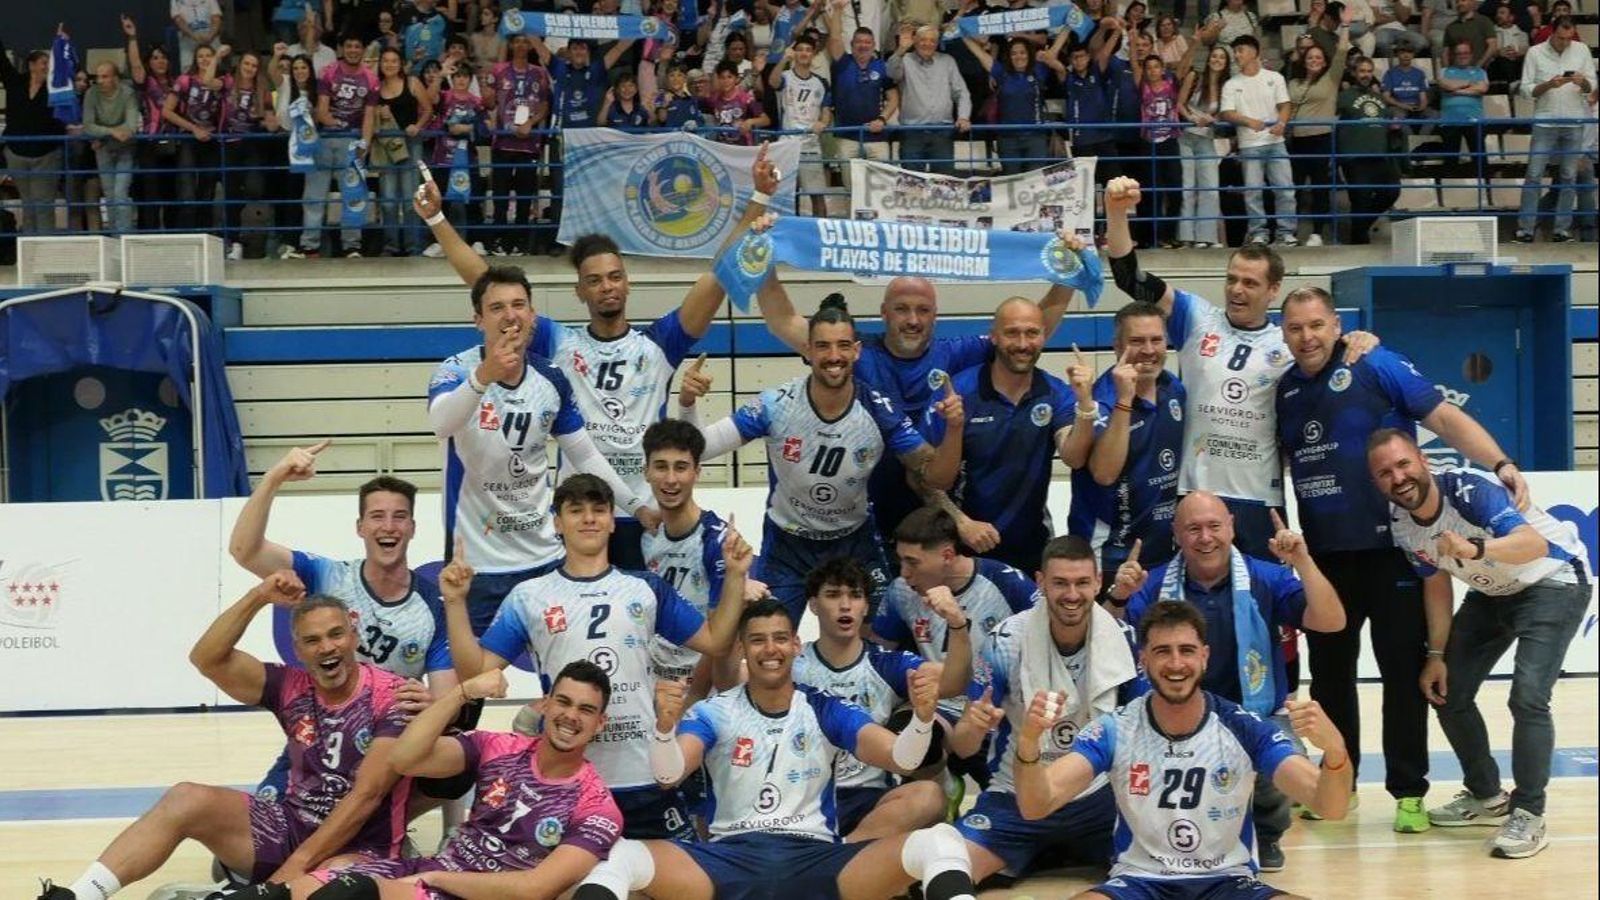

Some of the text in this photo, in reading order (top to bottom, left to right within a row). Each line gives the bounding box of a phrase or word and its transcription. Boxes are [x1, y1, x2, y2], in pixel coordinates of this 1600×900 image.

[797, 89, 811, 102] 17
[817, 218, 989, 254] CLUB VOLEIBOL
[819, 247, 989, 277] PLAYAS DE BENIDORM
[1227, 344, 1252, 371] 8
[595, 360, 626, 391] 15
[502, 411, 533, 446] 14
[585, 421, 647, 436] ERVIGROUP
[809, 445, 847, 478] 10
[587, 604, 611, 640] 2
[356, 625, 400, 664] 33
[1158, 767, 1207, 810] 29
[498, 800, 532, 834] 7
